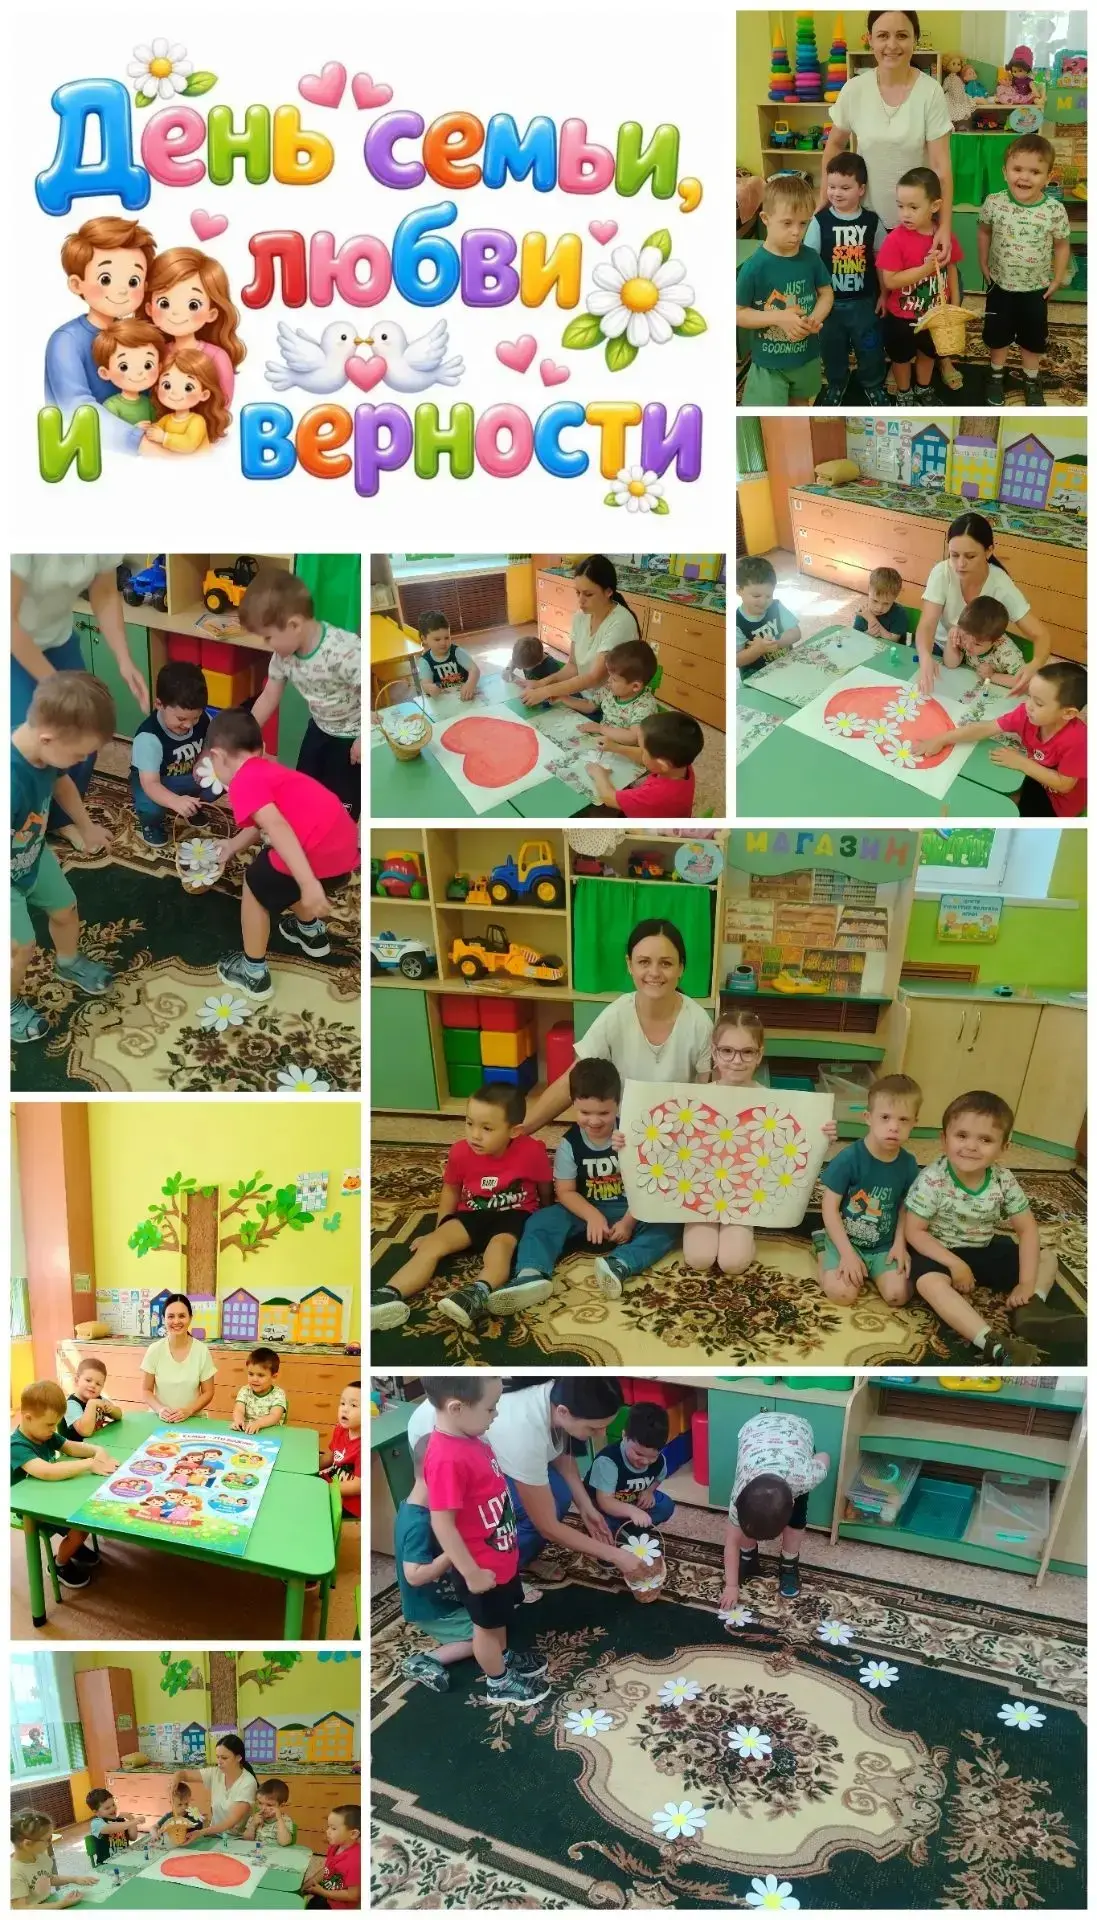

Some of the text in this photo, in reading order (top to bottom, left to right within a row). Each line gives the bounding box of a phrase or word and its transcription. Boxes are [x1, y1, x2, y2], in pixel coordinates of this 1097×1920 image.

[832, 225, 867, 246] TRY
[832, 244, 866, 261] SOME
[832, 259, 866, 274] THING
[784, 280, 806, 295] JUST
[831, 272, 865, 292] NEW
[433, 661, 459, 678] TRY
[746, 831, 910, 868] МАГАЗИН
[867, 1186, 893, 1200] JUST
